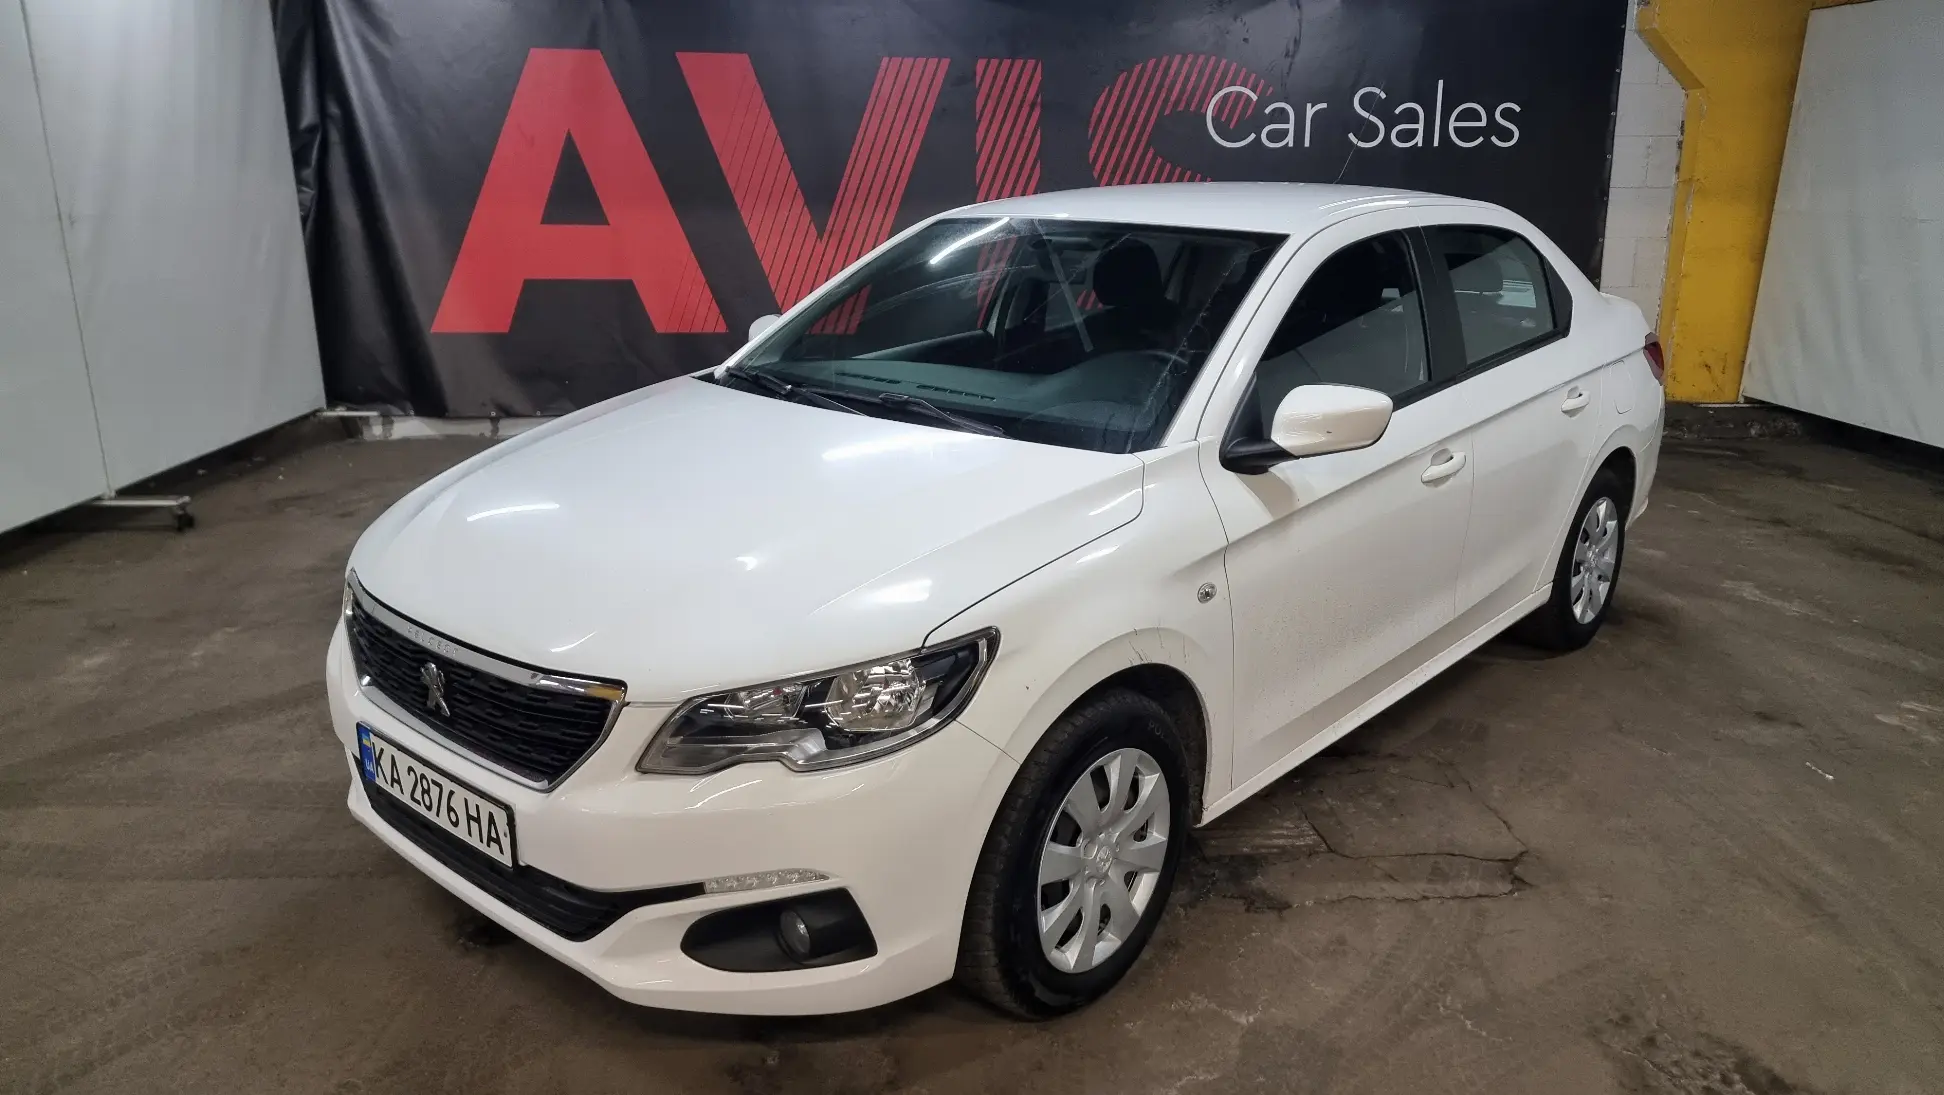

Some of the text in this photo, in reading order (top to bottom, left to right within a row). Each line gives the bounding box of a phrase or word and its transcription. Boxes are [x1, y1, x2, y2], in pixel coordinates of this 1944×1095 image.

[1206, 79, 1522, 148] Car Sales
[371, 741, 505, 856] KA 2876 HA
